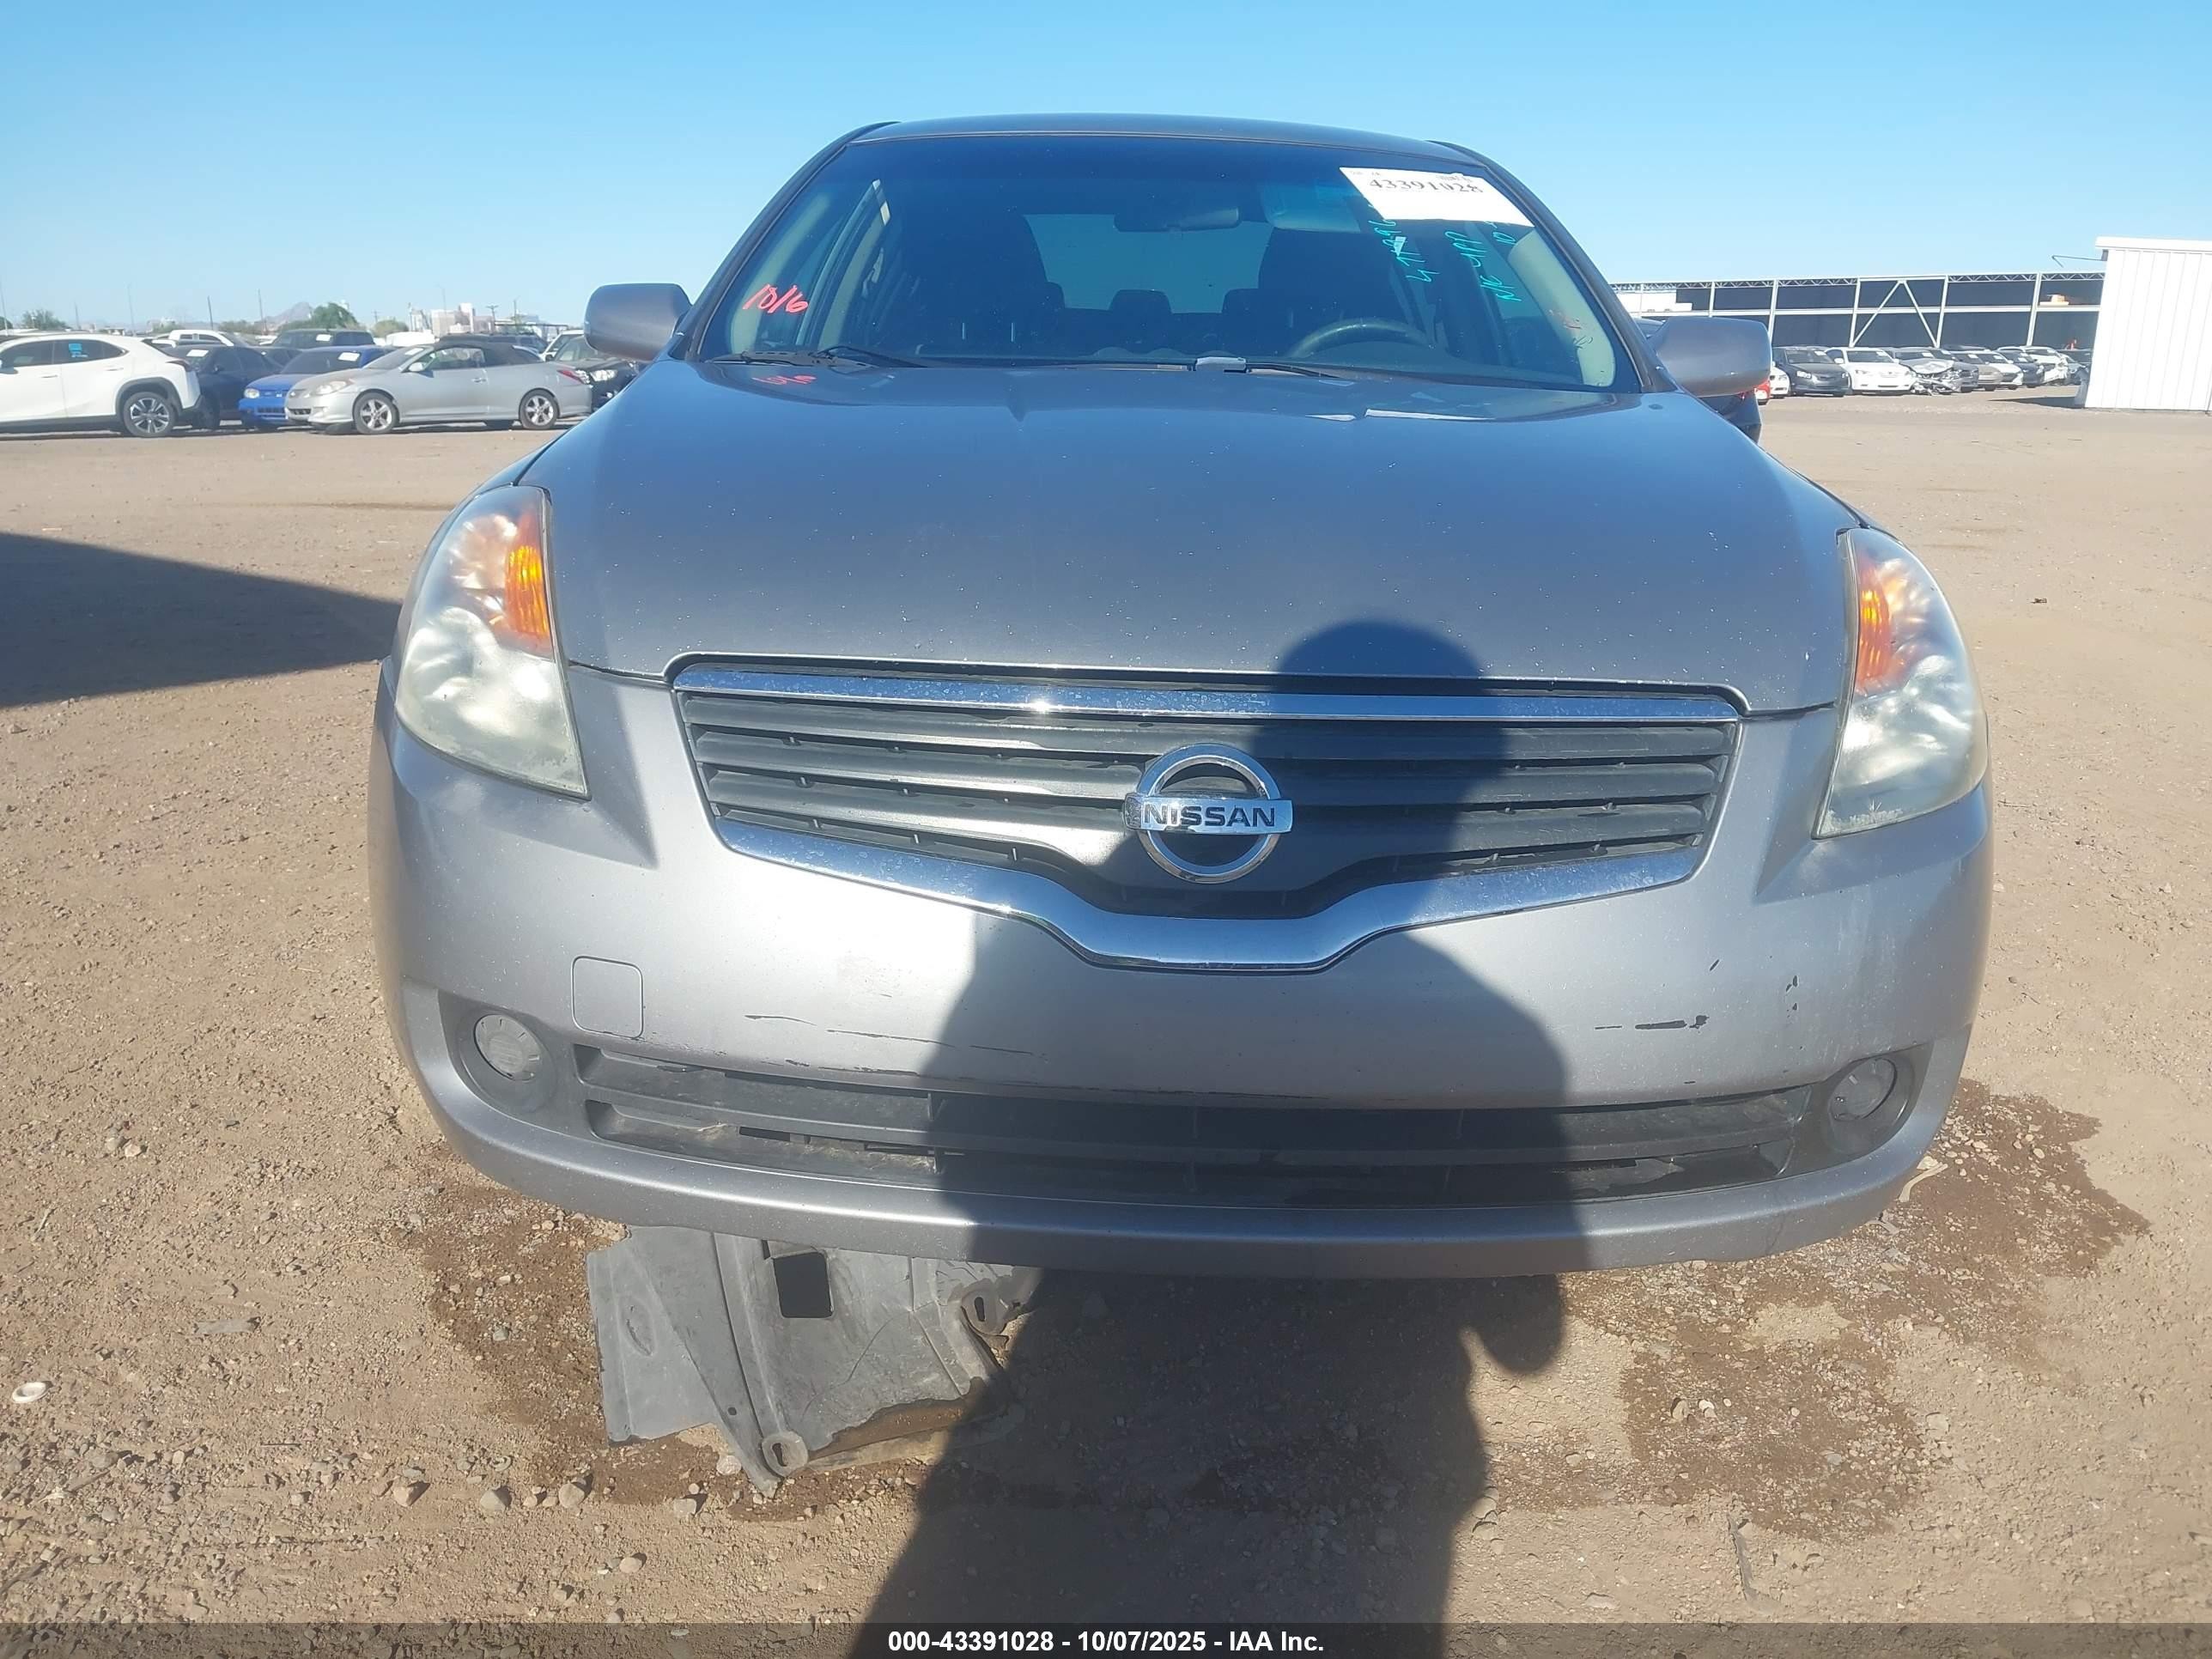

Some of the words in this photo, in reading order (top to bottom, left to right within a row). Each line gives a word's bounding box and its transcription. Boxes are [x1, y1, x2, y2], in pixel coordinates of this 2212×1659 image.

[1369, 179, 1483, 193] 43391028
[742, 283, 809, 314] 10/6
[1144, 802, 1274, 828] NISSAN
